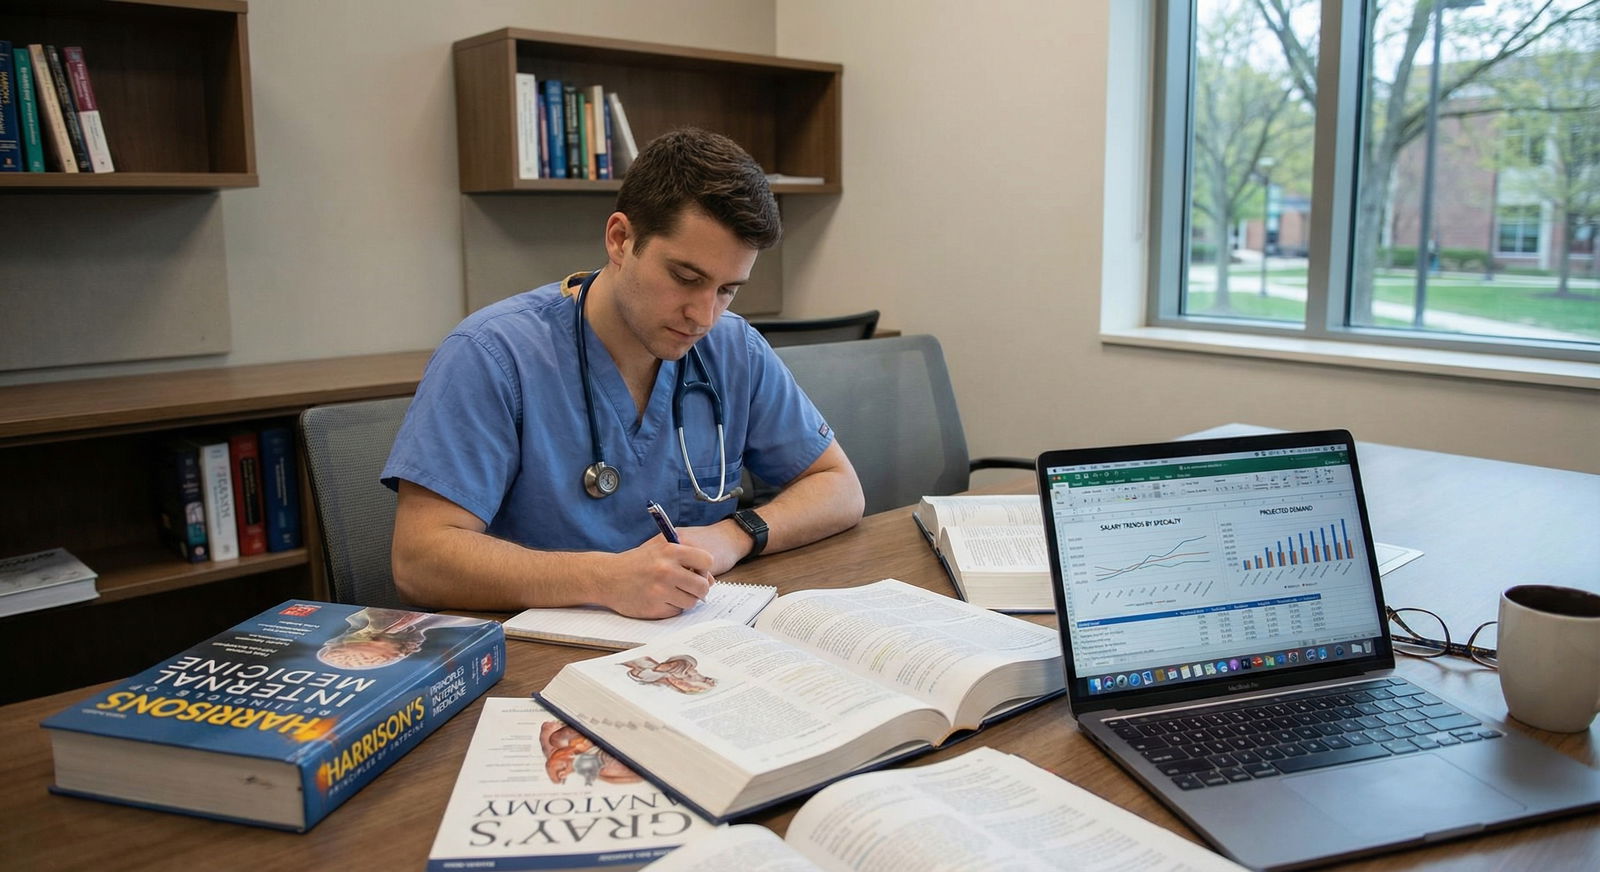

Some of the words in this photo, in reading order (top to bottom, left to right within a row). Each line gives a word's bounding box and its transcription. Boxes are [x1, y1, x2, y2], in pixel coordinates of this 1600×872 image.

[154, 670, 356, 708] INTERNAL
[168, 656, 376, 692] MEDICINE
[96, 691, 321, 736] HARRISONS
[327, 696, 425, 786] HARRISON'S
[469, 810, 692, 847] GRAY'S
